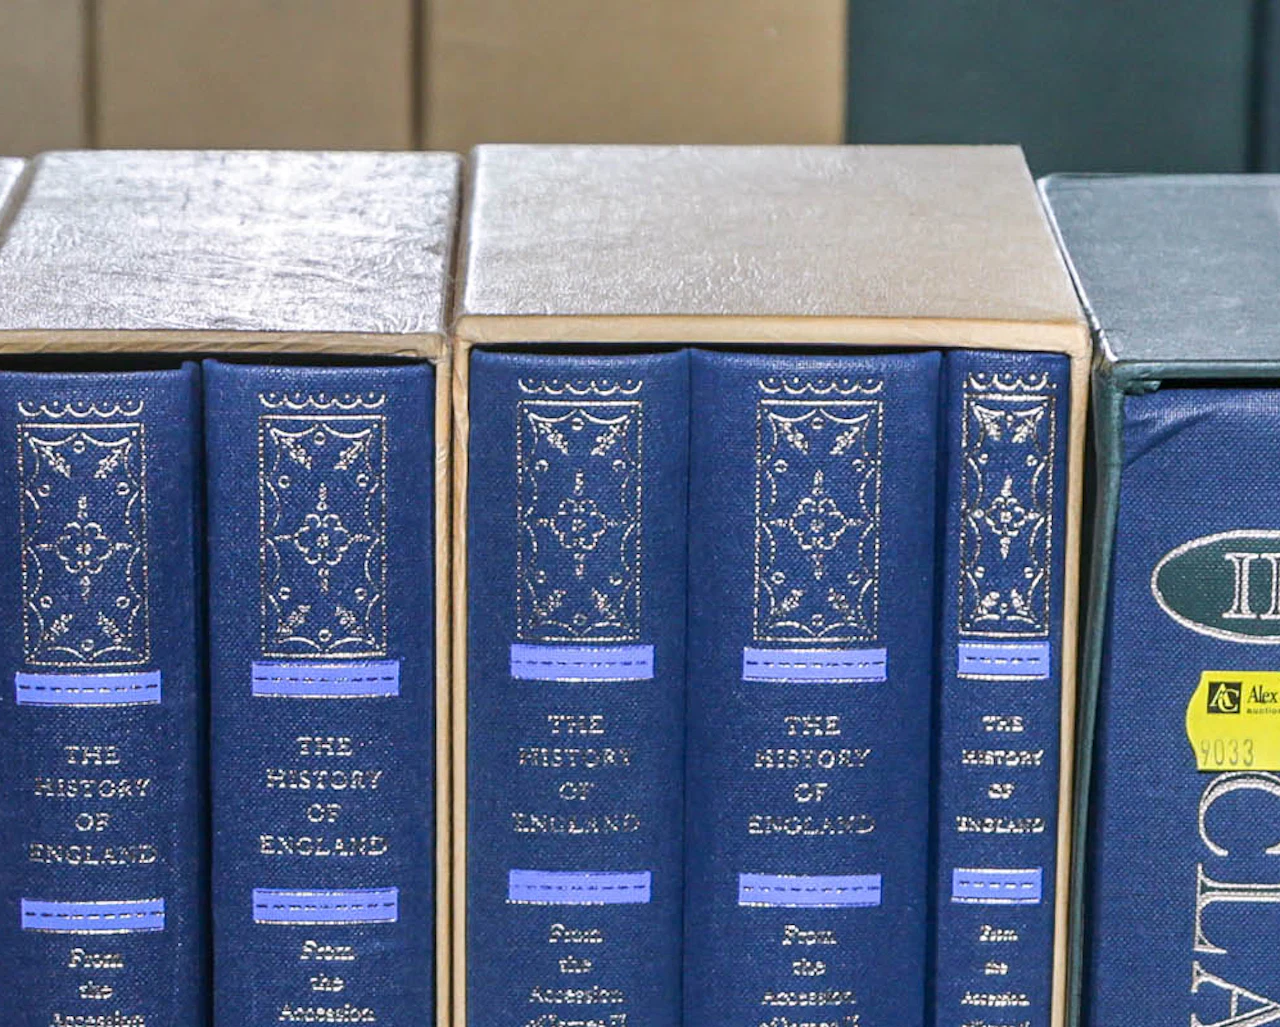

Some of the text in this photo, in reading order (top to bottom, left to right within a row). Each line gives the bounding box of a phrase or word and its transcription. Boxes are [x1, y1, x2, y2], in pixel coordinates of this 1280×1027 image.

[1247, 685, 1278, 704] Alex
[784, 715, 840, 735] THE
[64, 746, 120, 765] THE
[296, 736, 353, 756] THE
[1200, 738, 1254, 767] 9033
[754, 748, 871, 768] HISTORY
[34, 778, 150, 798] HISTORY
[266, 768, 383, 789] HISTORY
[794, 783, 829, 802] OF
[75, 813, 111, 832] OF
[306, 803, 341, 823] OF
[748, 814, 875, 835] ENGLAND
[29, 843, 157, 865] ENGLAND
[259, 834, 388, 856] ENGLAND
